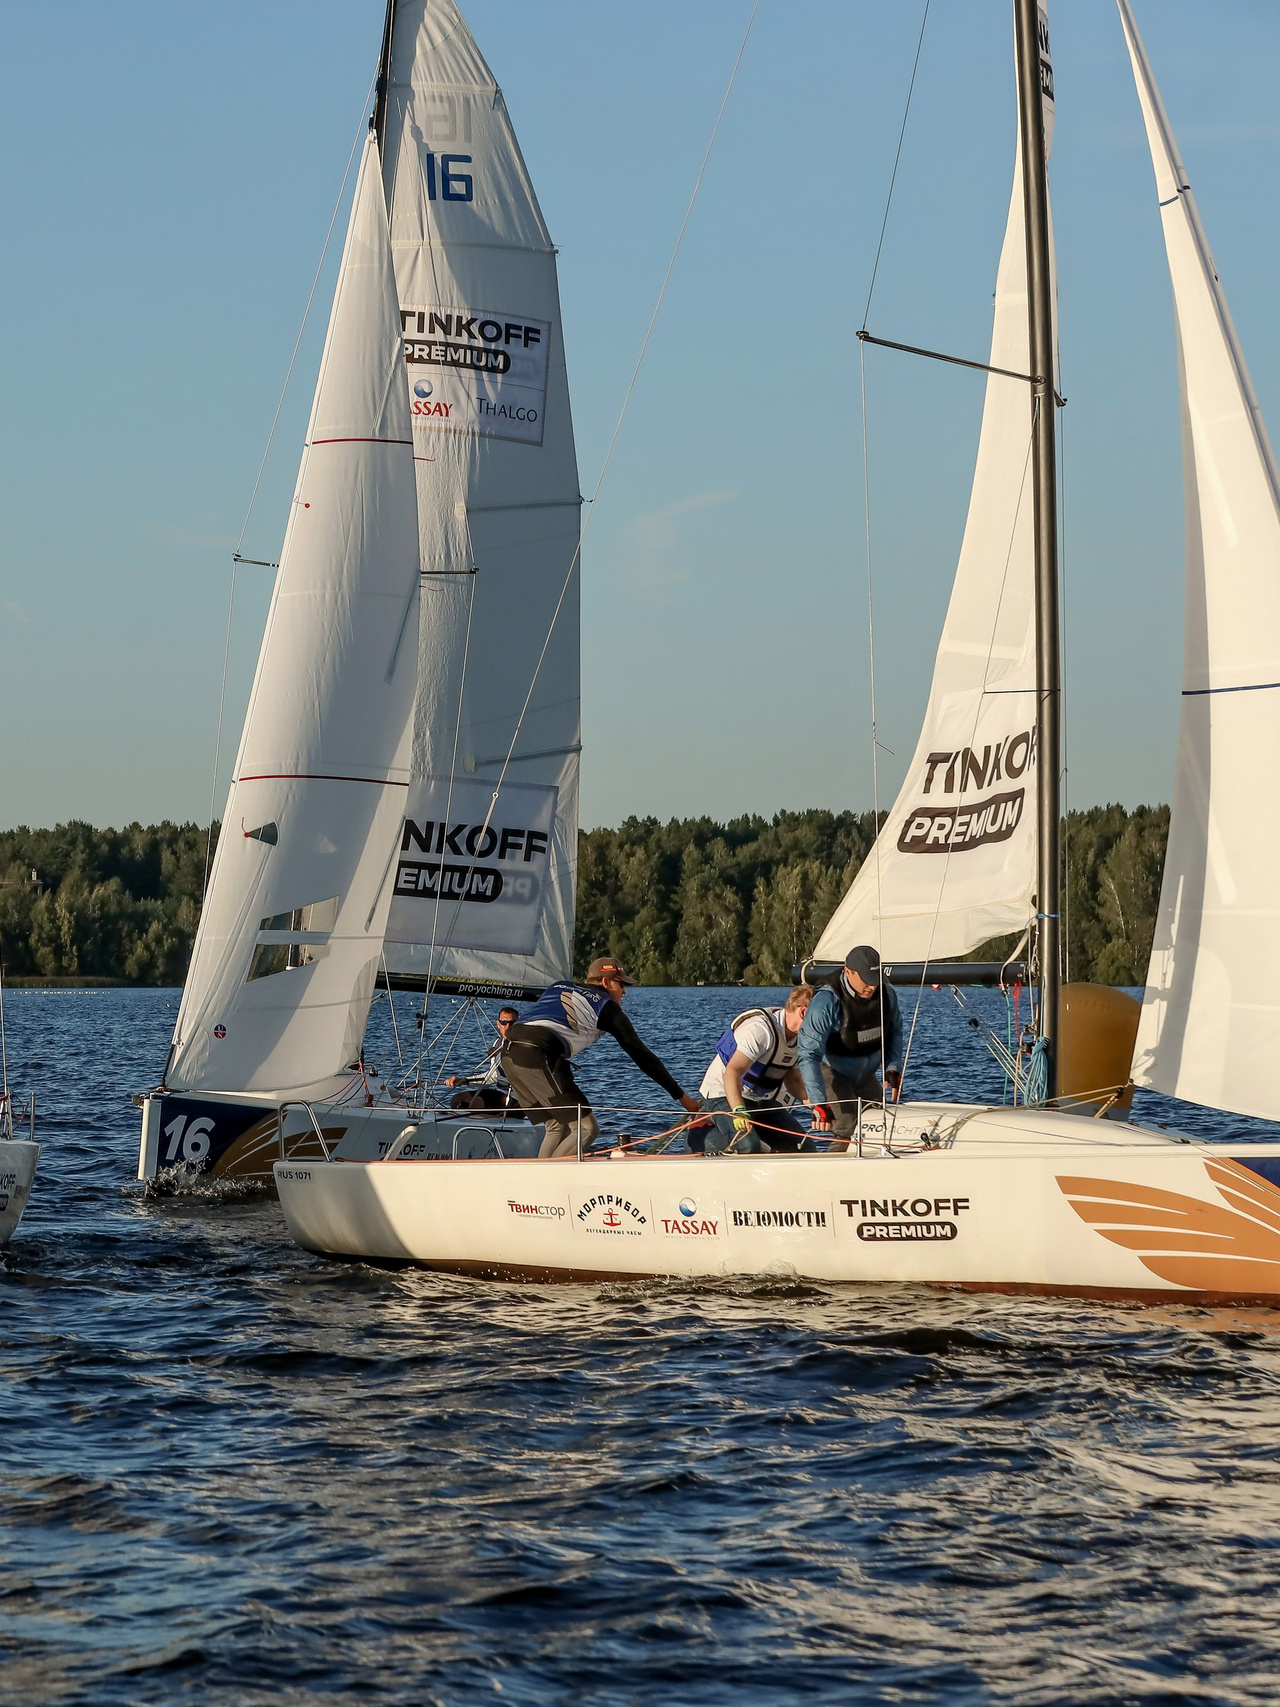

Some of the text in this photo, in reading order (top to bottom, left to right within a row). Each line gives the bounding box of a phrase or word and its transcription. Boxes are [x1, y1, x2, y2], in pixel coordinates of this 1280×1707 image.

[426, 153, 473, 202] 16
[400, 310, 541, 348] TINKOFF
[404, 344, 504, 370] PREMIUM
[410, 400, 453, 418] SSAY
[476, 396, 538, 423] THALGO
[904, 796, 1022, 845] PREMIUM
[401, 819, 548, 863] NKOFF
[397, 867, 495, 897] EMIUM
[458, 982, 524, 998] pro-yachting.ru
[164, 1114, 216, 1161] 16
[277, 1171, 312, 1180] RUS 1071
[577, 1194, 647, 1225] МОРПРИБОР
[732, 1210, 827, 1228] ВЕДОМОСТИ
[840, 1198, 970, 1217] TINKOFF
[661, 1219, 719, 1236] TASSAY
[862, 1224, 952, 1238] PREMIUM
